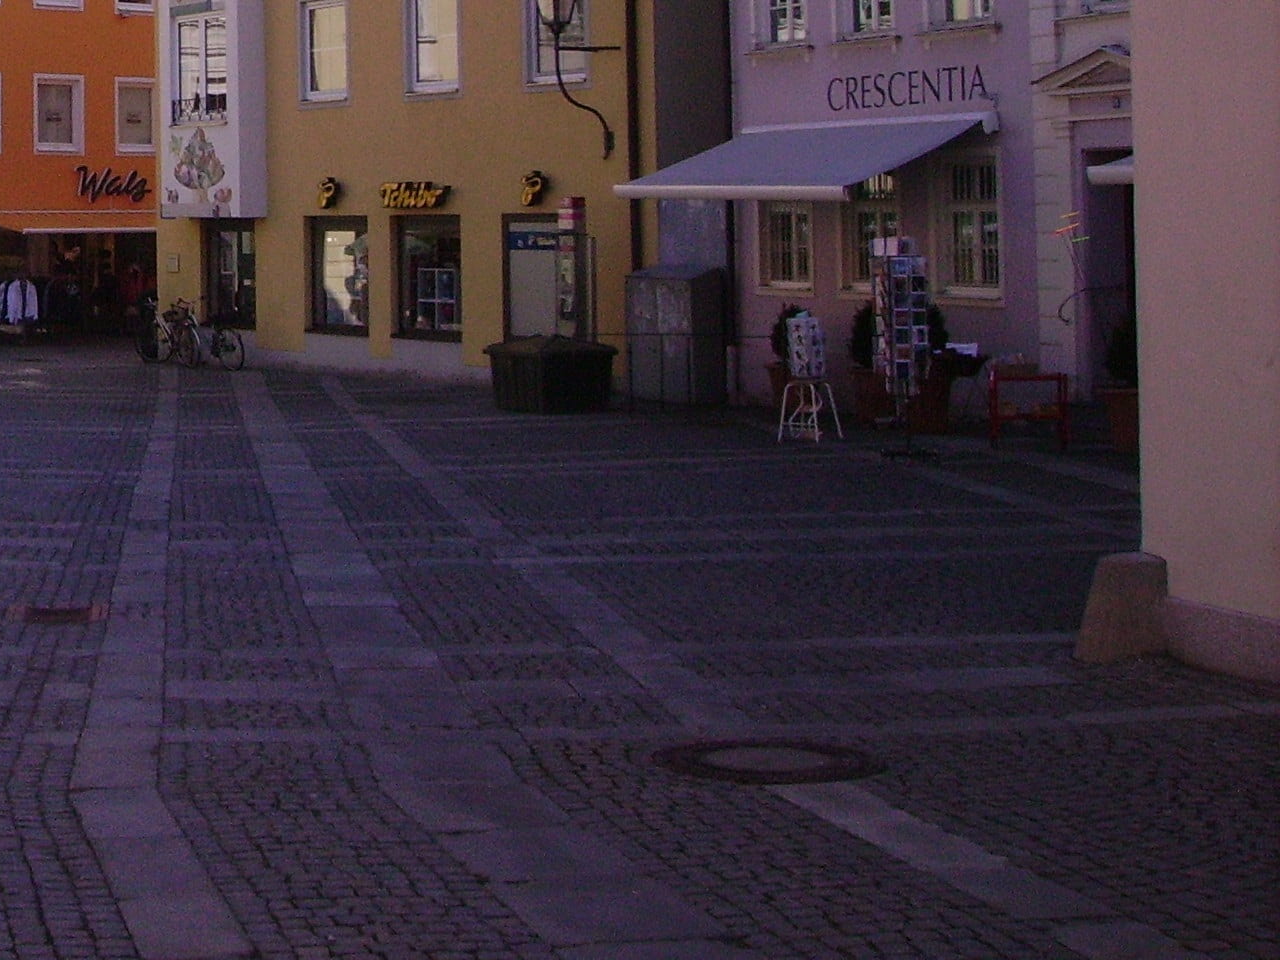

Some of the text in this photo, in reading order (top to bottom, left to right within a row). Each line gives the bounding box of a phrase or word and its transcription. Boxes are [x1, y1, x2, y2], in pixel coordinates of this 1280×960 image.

[827, 64, 988, 112] CRESCENTIA
[74, 164, 153, 204] Walz
[380, 181, 450, 208] Tchibo
